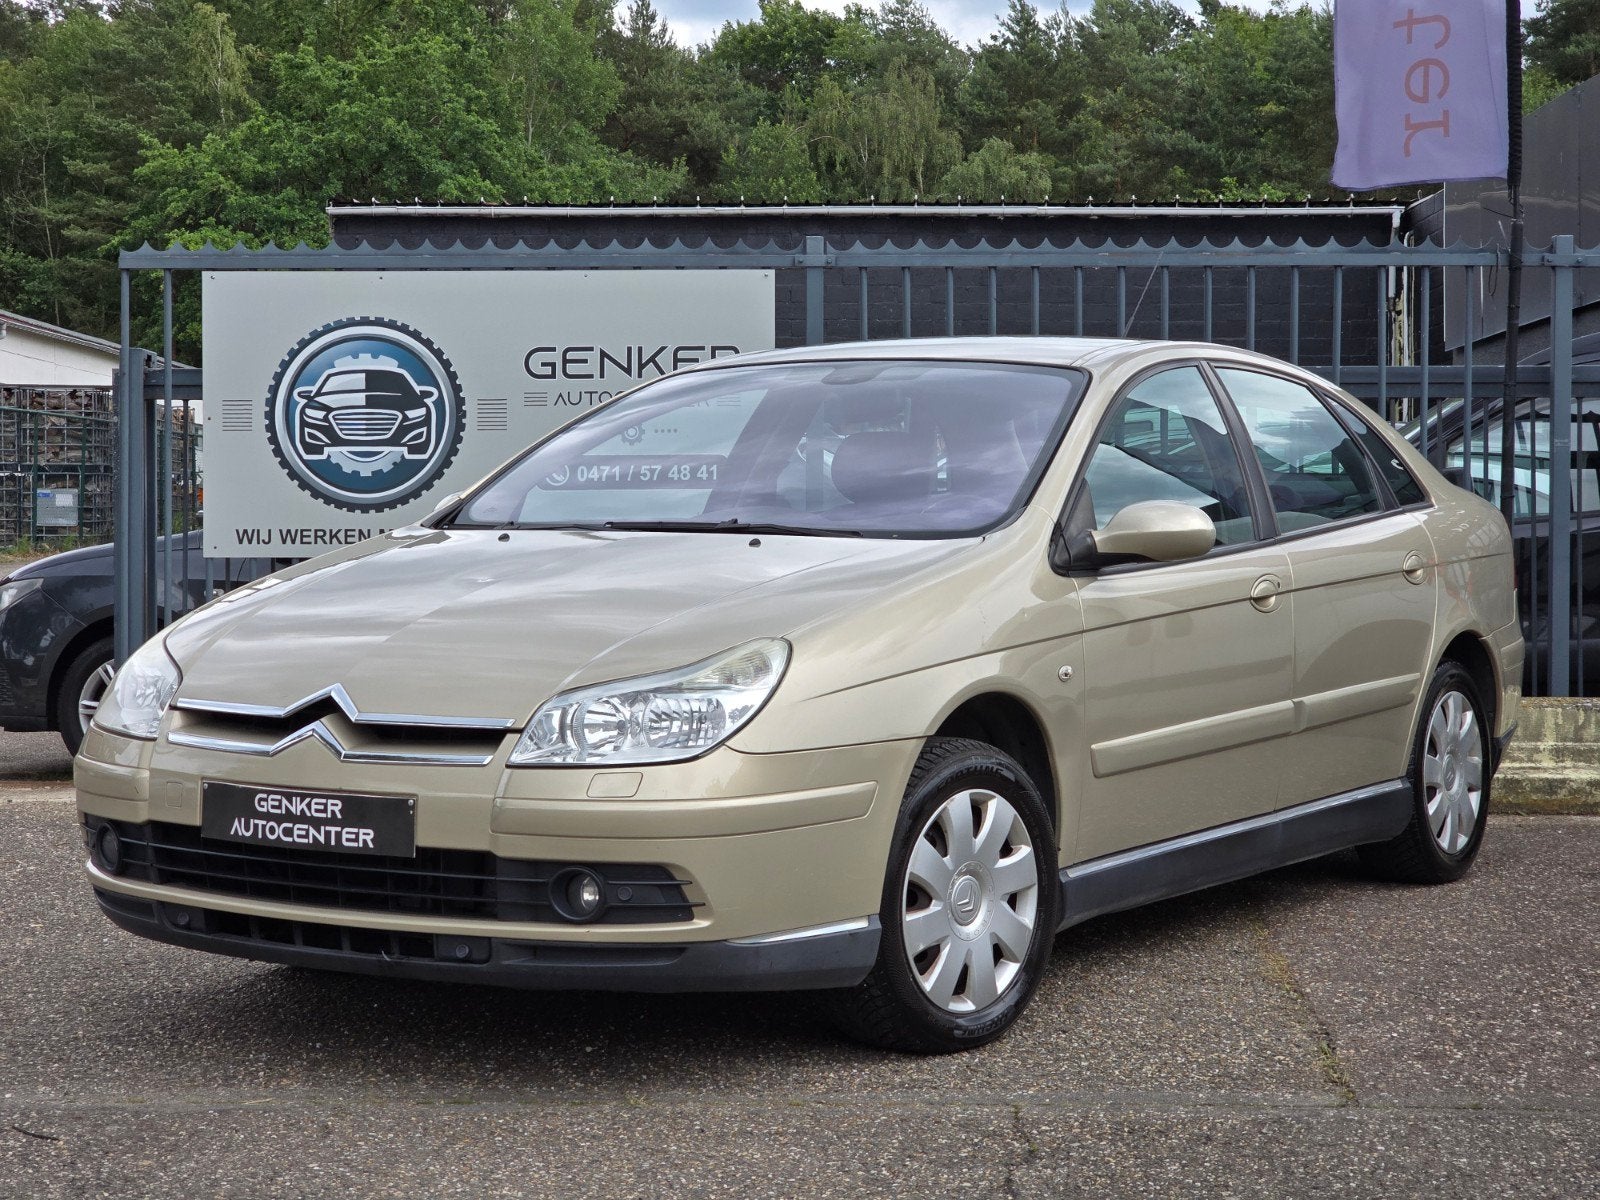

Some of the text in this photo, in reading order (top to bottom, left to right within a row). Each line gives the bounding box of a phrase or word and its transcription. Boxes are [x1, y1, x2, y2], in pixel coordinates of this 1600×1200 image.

[577, 465, 620, 482] 0471
[640, 464, 662, 481] 57
[668, 464, 691, 481] 48
[697, 464, 718, 481] 41
[236, 528, 271, 545] WIJ
[279, 528, 371, 545] WERKEN
[254, 793, 342, 819] GENKER
[230, 817, 375, 849] AUTOCENTER
